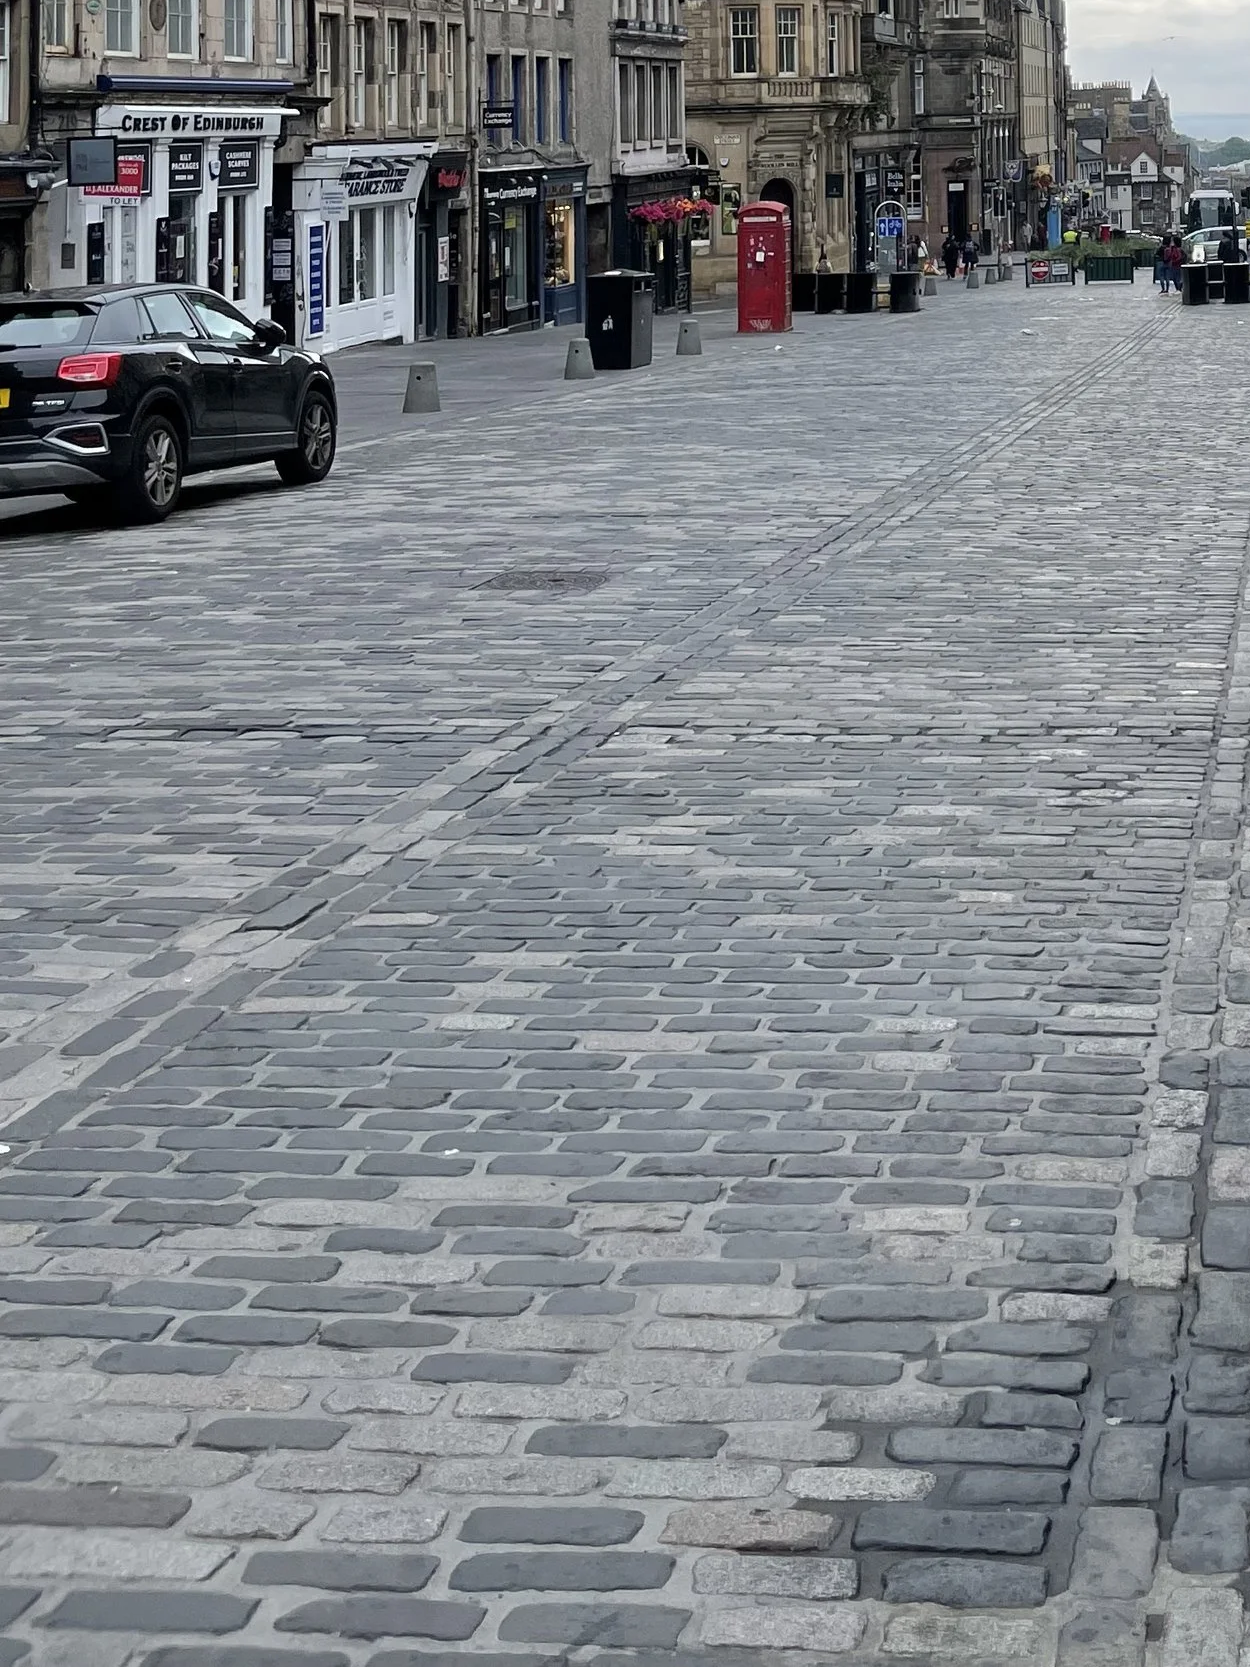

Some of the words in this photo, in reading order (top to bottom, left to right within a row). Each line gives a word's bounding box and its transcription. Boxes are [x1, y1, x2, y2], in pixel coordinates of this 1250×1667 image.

[122, 115, 167, 131] CREST
[193, 115, 264, 131] EDINBURGH
[171, 162, 199, 170] PACKAGES
[228, 160, 249, 168] SCARVES
[120, 167, 138, 175] 3000
[347, 180, 381, 197] ARANCE
[380, 178, 407, 195] STORE
[122, 197, 138, 205] LET
